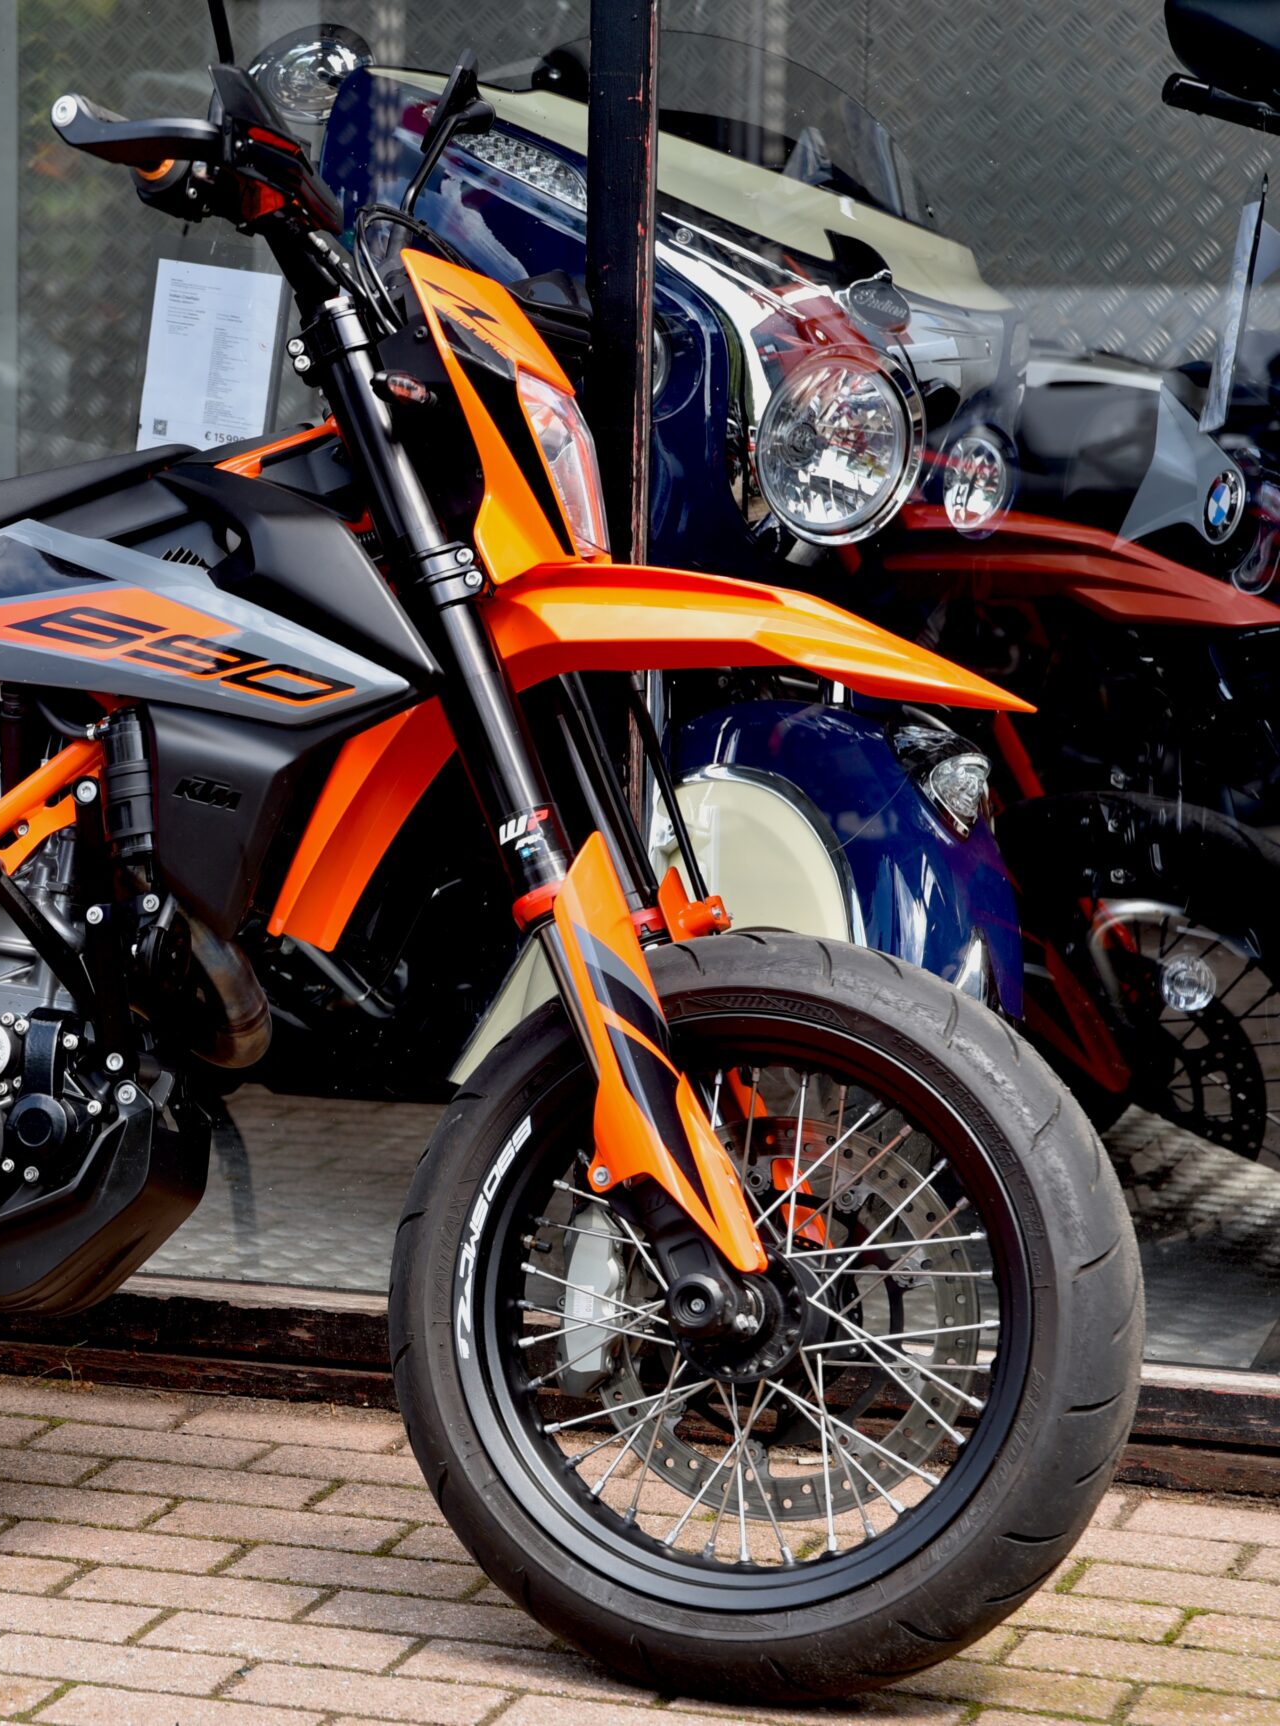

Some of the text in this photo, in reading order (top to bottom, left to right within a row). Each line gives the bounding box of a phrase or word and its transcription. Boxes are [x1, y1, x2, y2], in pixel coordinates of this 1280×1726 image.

[853, 289, 908, 319] Indian
[5, 606, 356, 706] 690
[172, 776, 243, 811] KTM
[498, 809, 549, 846] WP
